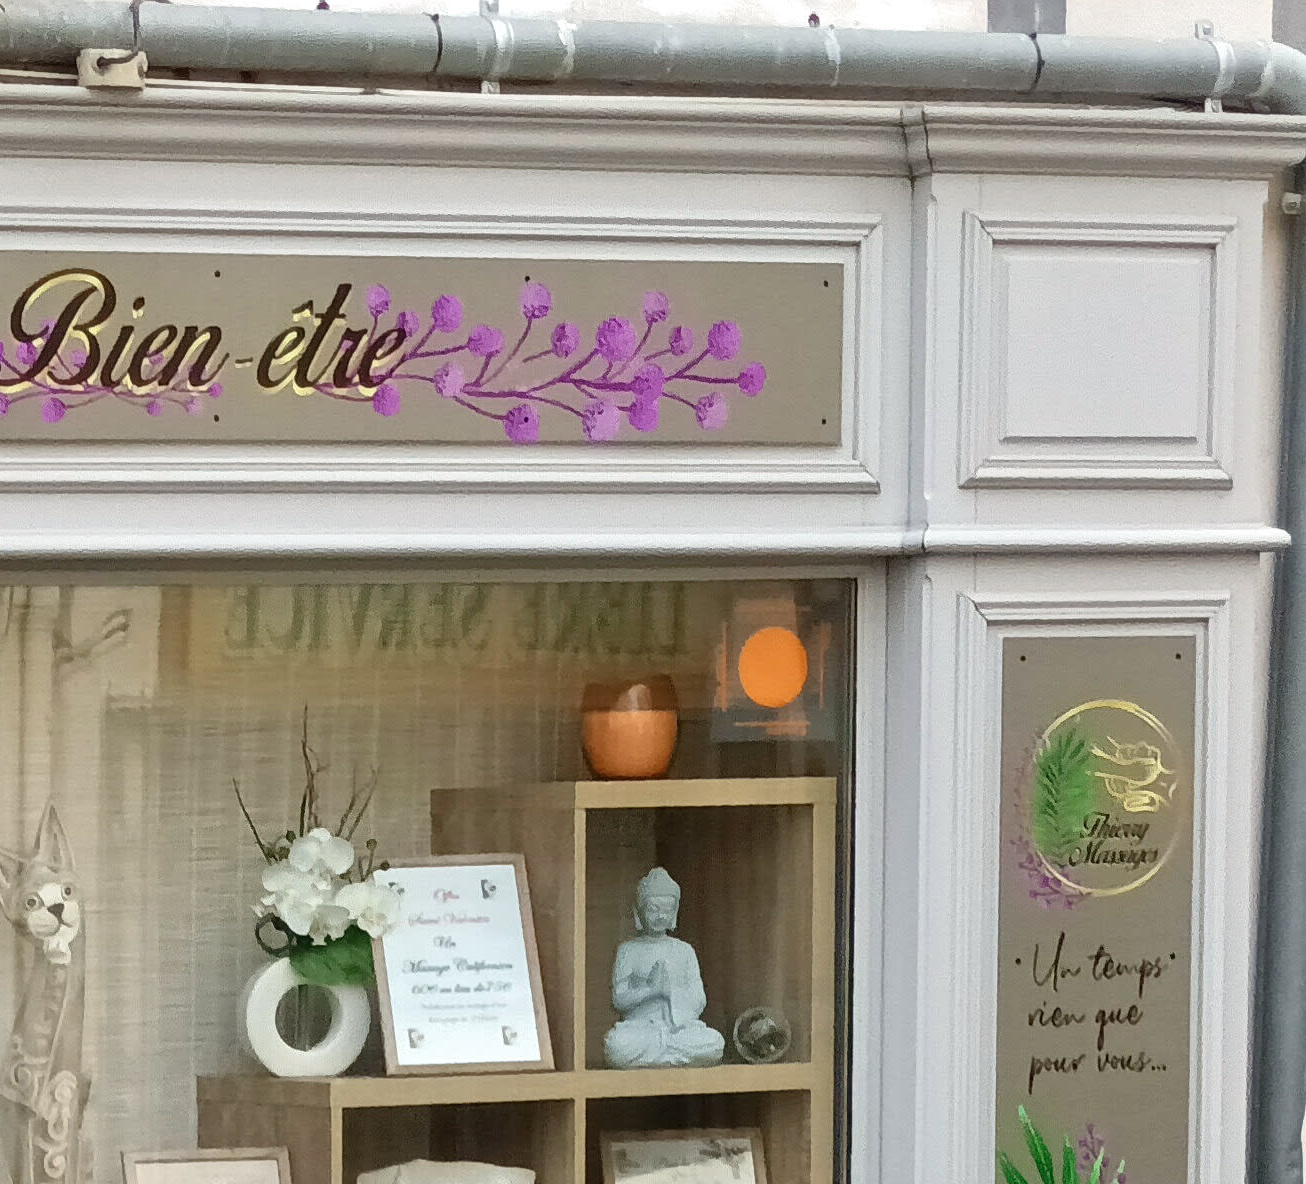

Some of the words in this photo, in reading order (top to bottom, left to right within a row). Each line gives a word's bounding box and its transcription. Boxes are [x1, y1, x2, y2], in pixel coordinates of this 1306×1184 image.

[1080, 811, 1150, 847] Thierry
[1068, 840, 1158, 872] Massages
[1033, 931, 1081, 992] Un
[1088, 945, 1163, 999] temps
[1028, 1001, 1086, 1029] rien
[1095, 1005, 1143, 1051] que
[1028, 1054, 1086, 1095] pour
